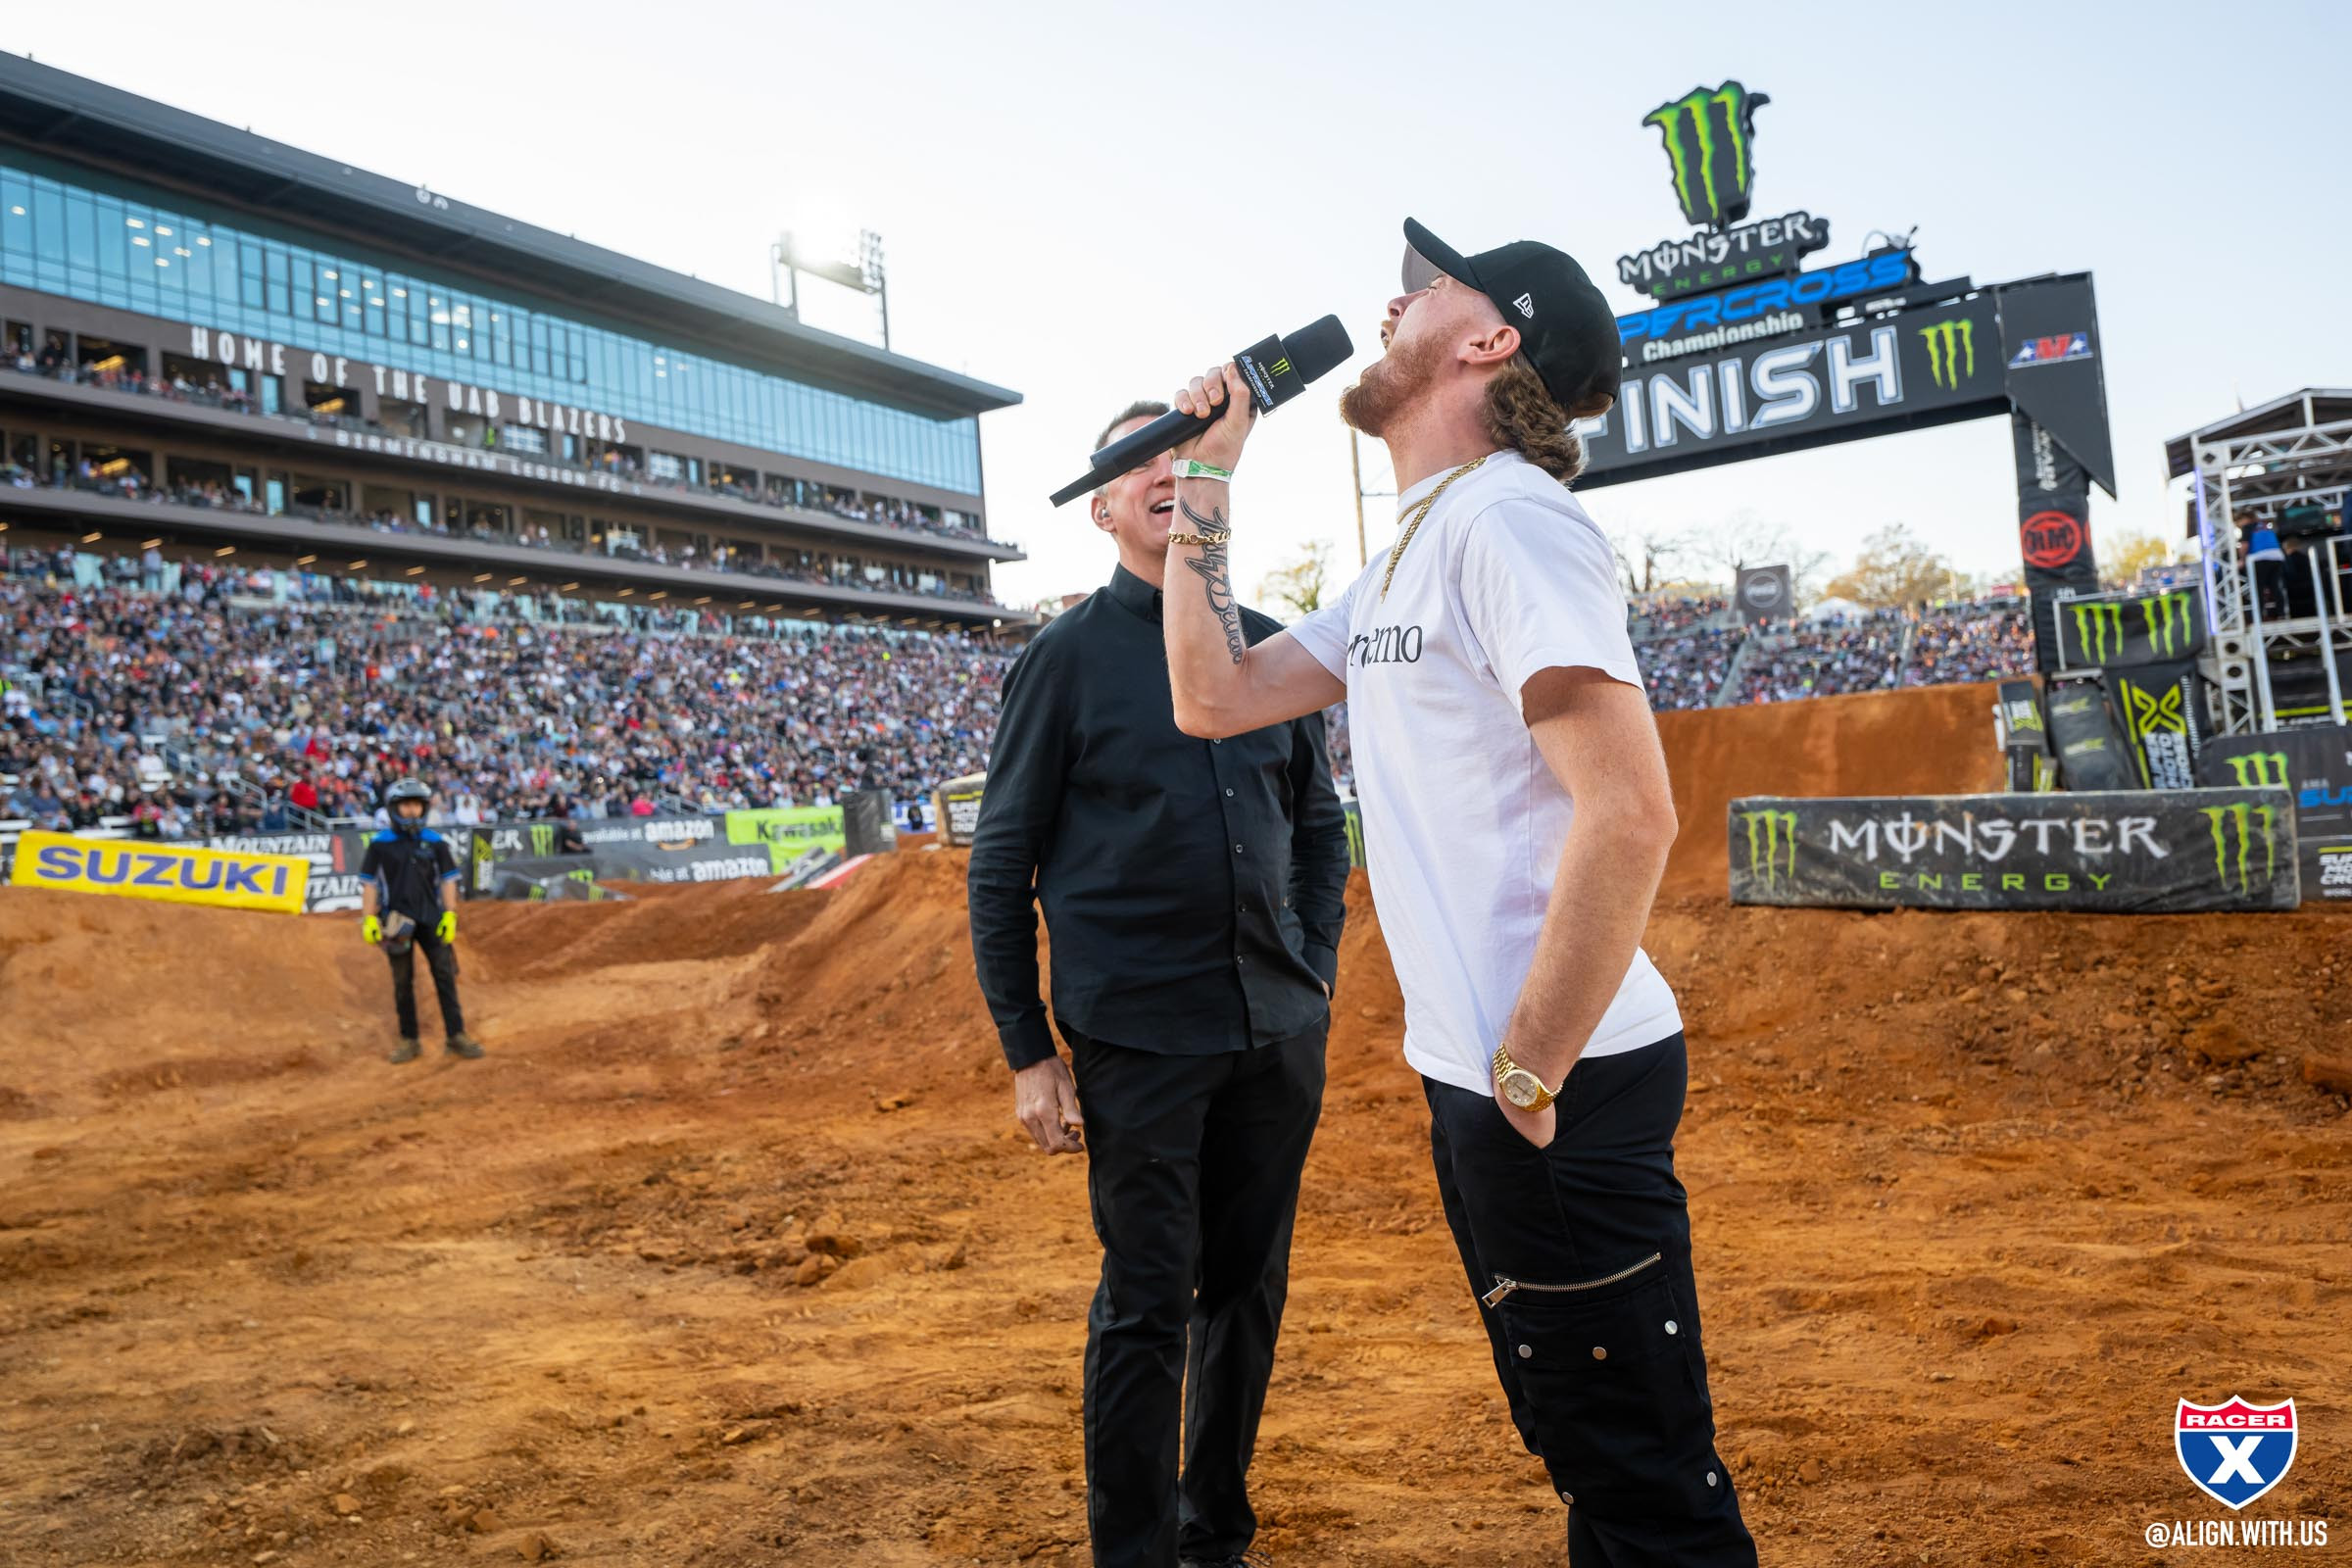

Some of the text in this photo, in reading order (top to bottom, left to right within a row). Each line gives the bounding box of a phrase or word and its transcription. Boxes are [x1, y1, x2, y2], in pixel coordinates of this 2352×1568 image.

[1621, 214, 1813, 281] MONSTER
[1652, 253, 1784, 295] ENERGY
[1642, 311, 1804, 363] Championship
[191, 325, 626, 444] HOME OF THE UAB BLAZERS
[336, 429, 497, 471] BIRMINGHAM
[510, 461, 586, 487] LEGION
[645, 818, 714, 843] amazon
[1828, 811, 2170, 863] MONSTER
[36, 846, 288, 897] SUZUKI
[1879, 872, 2111, 891] ENERGY
